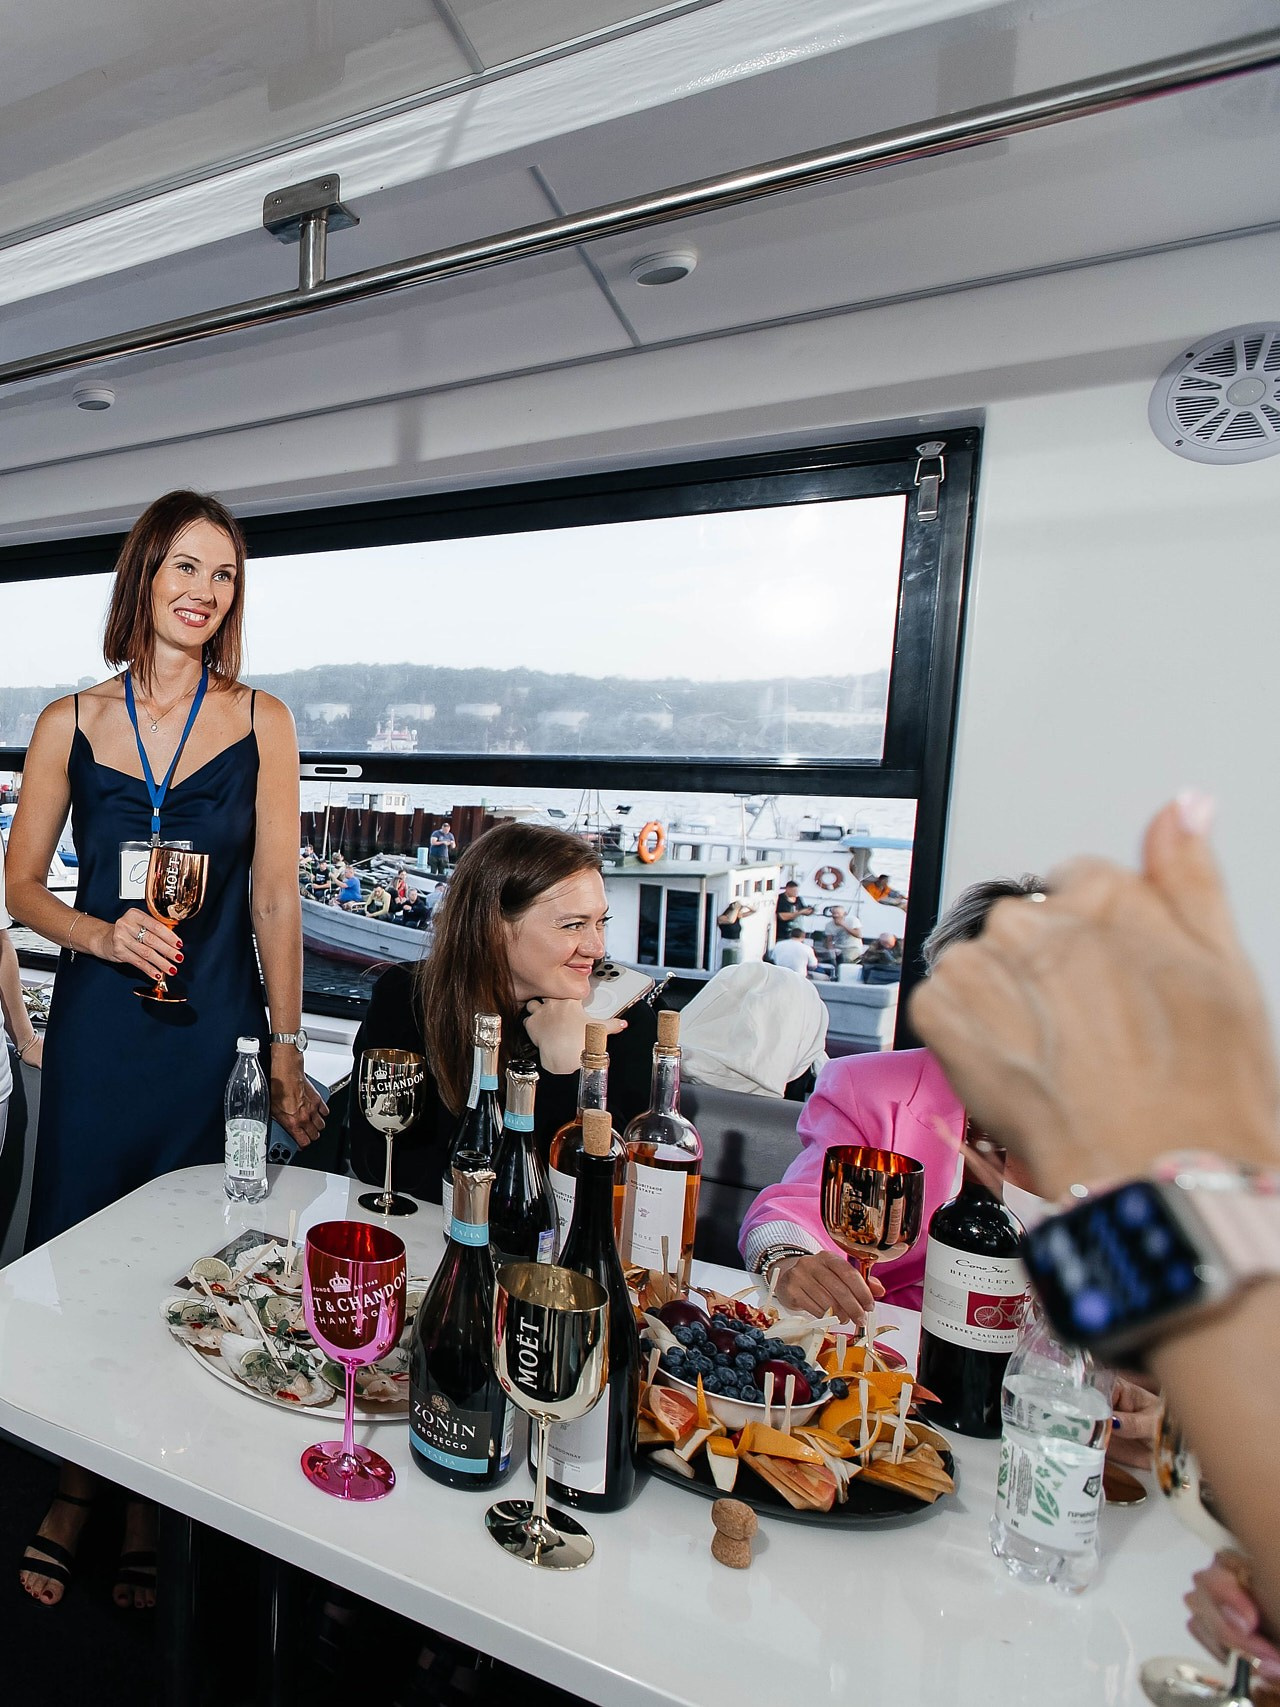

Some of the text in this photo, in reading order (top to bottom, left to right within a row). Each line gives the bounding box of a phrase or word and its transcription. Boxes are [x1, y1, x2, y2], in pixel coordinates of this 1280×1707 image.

[376, 1071, 424, 1092] CHANDON
[325, 1300, 336, 1313] &
[337, 1266, 406, 1312] CHANDON
[950, 1268, 1015, 1285] BICICLETA
[313, 1299, 397, 1325] CHAMPAGNE
[937, 1319, 974, 1335] CABERNET
[516, 1316, 540, 1390] MOËT
[414, 1400, 476, 1438] ZONIN
[417, 1423, 468, 1451] PROSECCO
[424, 1446, 456, 1466] ITALIA
